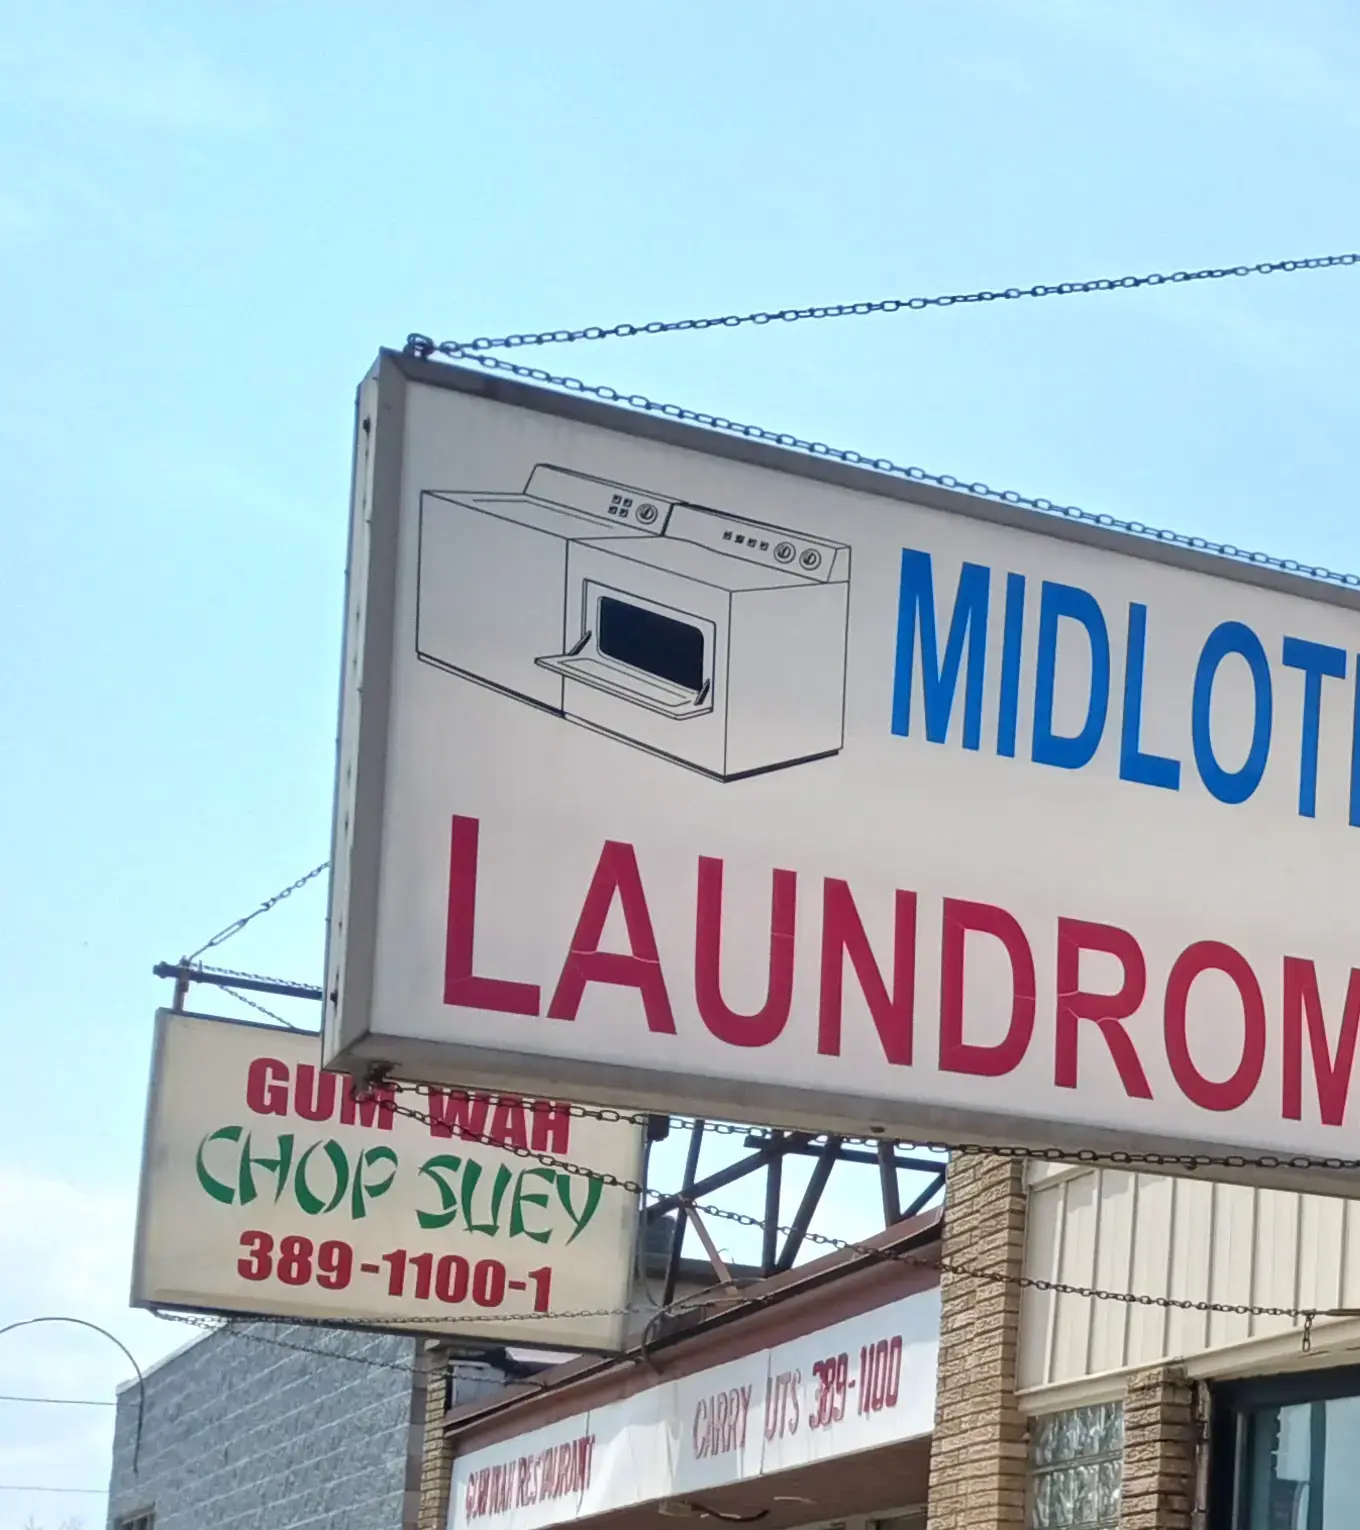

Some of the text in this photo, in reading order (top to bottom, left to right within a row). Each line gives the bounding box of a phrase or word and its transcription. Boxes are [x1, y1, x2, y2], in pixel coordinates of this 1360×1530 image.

[246, 1057, 572, 1155] GUM WAH
[196, 1126, 605, 1246] CHOP SUEY
[237, 1230, 553, 1313] 389-1100-1
[692, 1383, 753, 1459] CARRY
[808, 1334, 903, 1430] 389-1100
[516, 1433, 596, 1509] RESTAURANT
